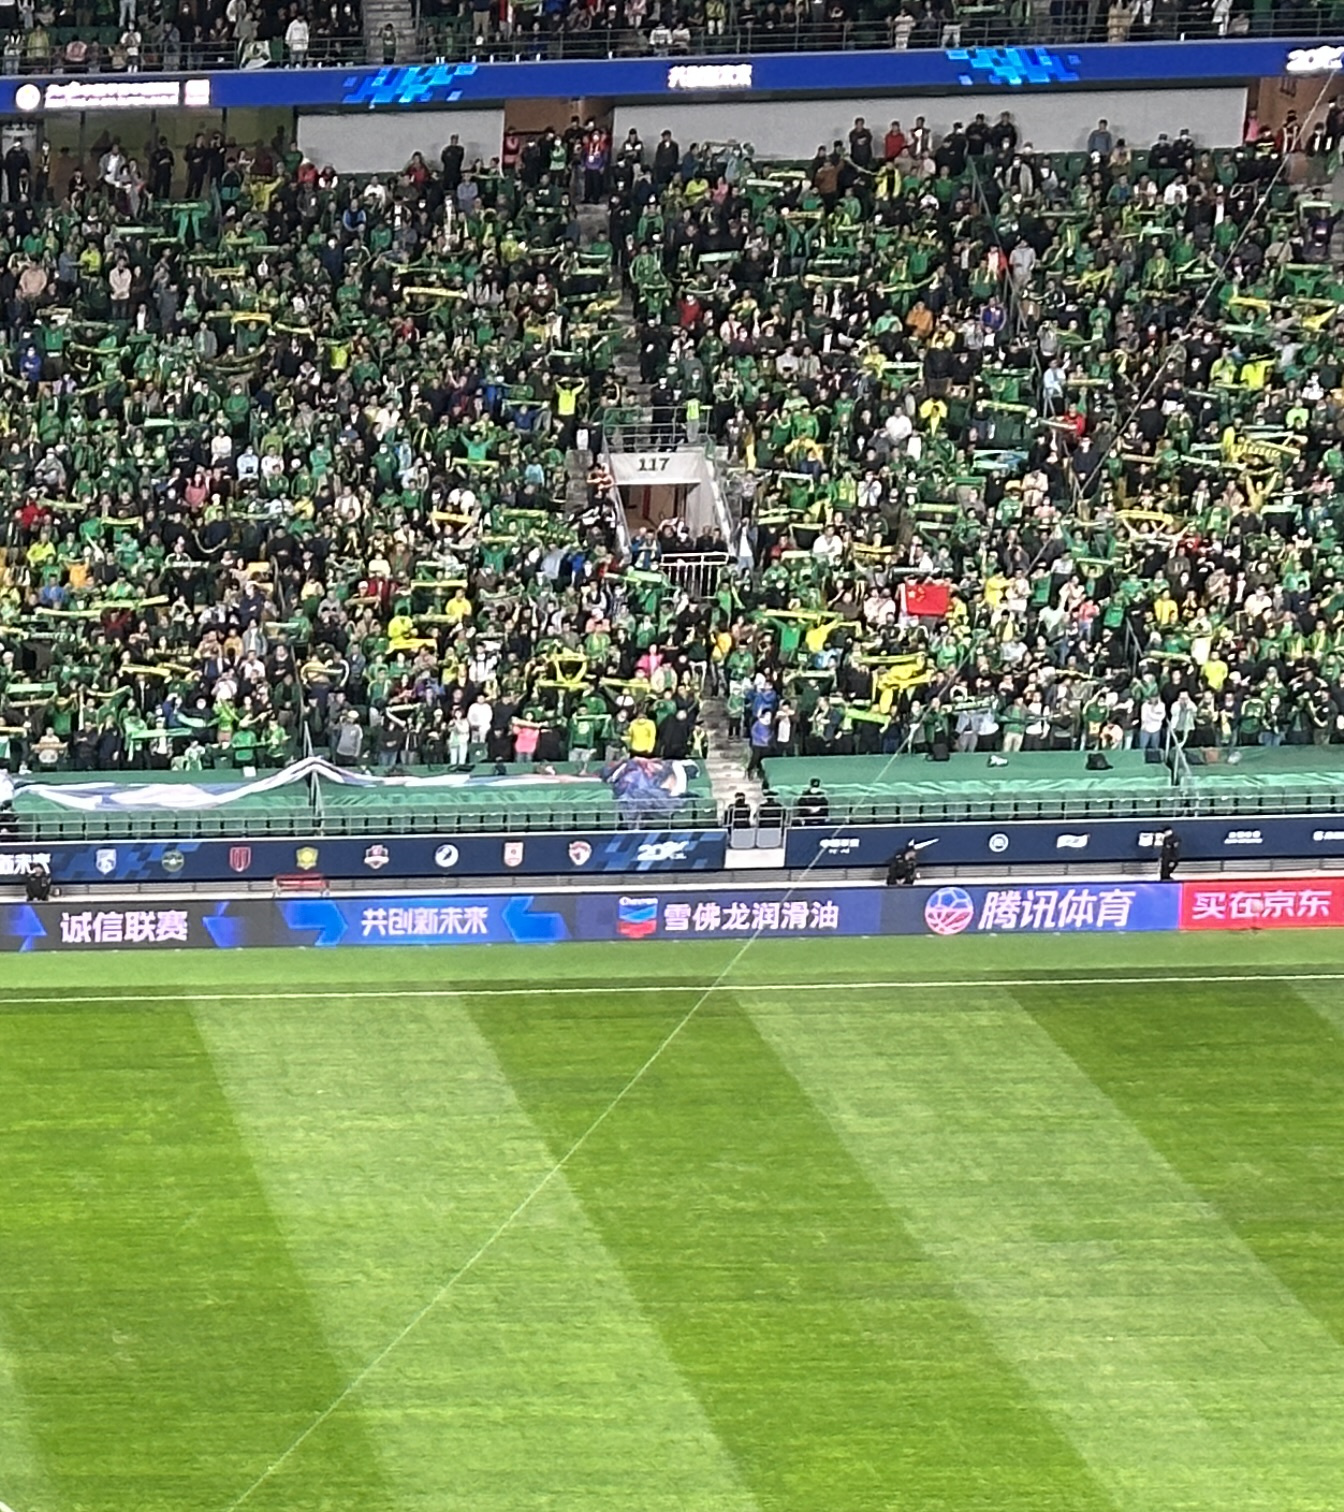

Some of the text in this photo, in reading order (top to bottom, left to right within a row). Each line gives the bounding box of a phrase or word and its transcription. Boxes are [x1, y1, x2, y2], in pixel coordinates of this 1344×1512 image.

[638, 457, 670, 471] 117
[664, 901, 839, 931] 雪佛龙润滑油
[978, 889, 1136, 930] 腾讯体育
[1192, 889, 1332, 920] 买在京东
[60, 909, 188, 944] 诚信联赛
[361, 905, 489, 936] 共创新未来
